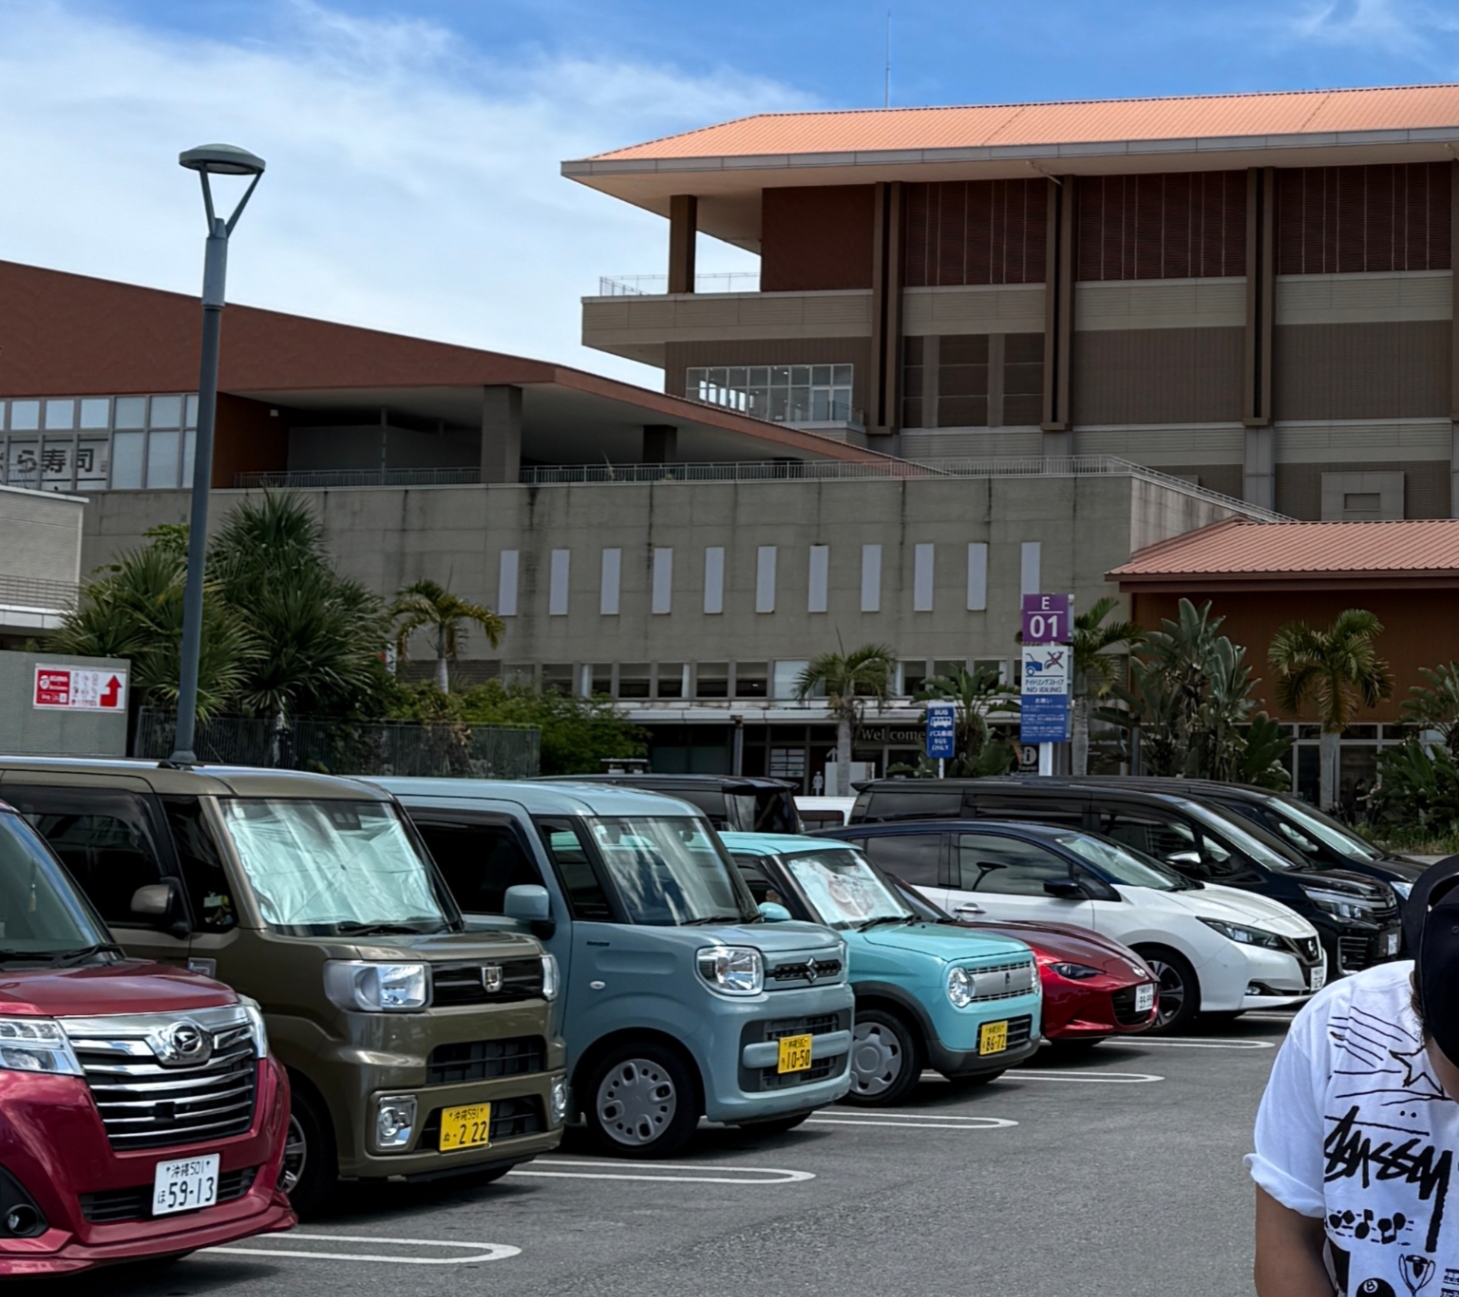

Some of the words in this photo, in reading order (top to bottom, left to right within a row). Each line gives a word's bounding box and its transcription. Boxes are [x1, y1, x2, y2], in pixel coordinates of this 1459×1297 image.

[0, 448, 94, 473] ら寿司
[1041, 596, 1050, 610] E
[1030, 615, 1058, 638] 01
[168, 1176, 214, 1208] 59-13
